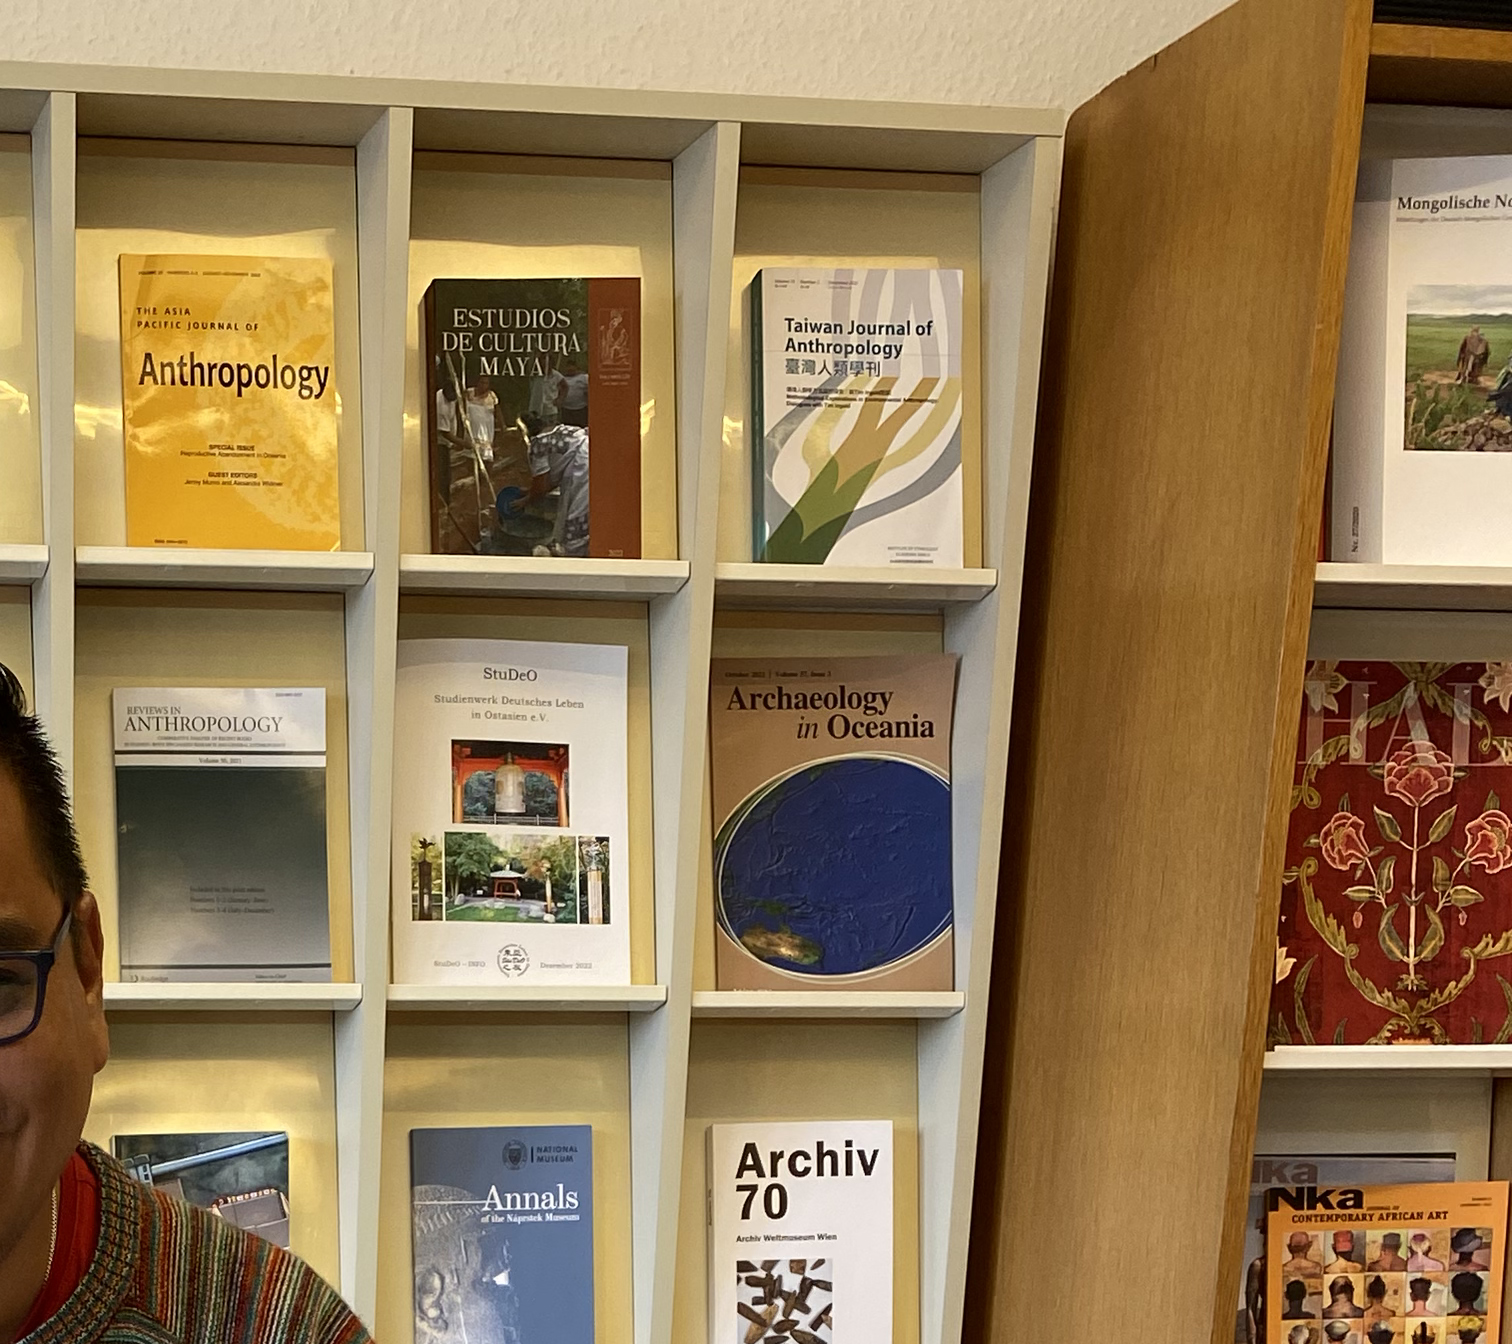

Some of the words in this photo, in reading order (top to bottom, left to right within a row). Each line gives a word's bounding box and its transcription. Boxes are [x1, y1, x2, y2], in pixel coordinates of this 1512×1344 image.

[1397, 195, 1490, 214] Mongolische
[137, 307, 157, 315] THE
[164, 307, 191, 315] ASIA
[453, 308, 571, 329] ESTUDIOS
[137, 321, 181, 329] PACIFIC
[187, 322, 238, 331] JOURNAL
[246, 323, 258, 331] OF
[784, 318, 843, 334] Taiwan
[847, 320, 910, 336] Journal
[915, 321, 933, 336] of
[442, 332, 473, 351] DE
[479, 332, 581, 356] CULTURA
[785, 338, 903, 359] Anthropology
[139, 351, 329, 400] Anthropology
[480, 356, 544, 377] MAYA
[483, 667, 538, 682] StuDeO
[434, 695, 498, 705] Studienwerk
[501, 696, 552, 707] Deutsches
[555, 699, 584, 709] Leben
[726, 684, 894, 716] Archaeology
[127, 706, 169, 715] REVIEWS
[170, 706, 181, 714] IN
[471, 711, 481, 719] in
[484, 711, 527, 721] Ostasien
[531, 713, 549, 722] e.V.
[124, 716, 284, 732] ANTHROPOLOGY
[796, 716, 820, 740] in
[826, 713, 935, 740] Oceania
[735, 1140, 880, 1179] Archiv
[482, 1183, 579, 1211] Annals
[736, 1183, 788, 1220] 70
[1265, 1186, 1364, 1212] Nka
[1292, 1213, 1376, 1224] CONTEMPORARY
[1378, 1212, 1424, 1222] AFRICAN
[1427, 1211, 1449, 1220] ART
[736, 1235, 761, 1243] Archiv
[763, 1234, 815, 1242] Weltmuseum
[817, 1233, 837, 1241] Wien
